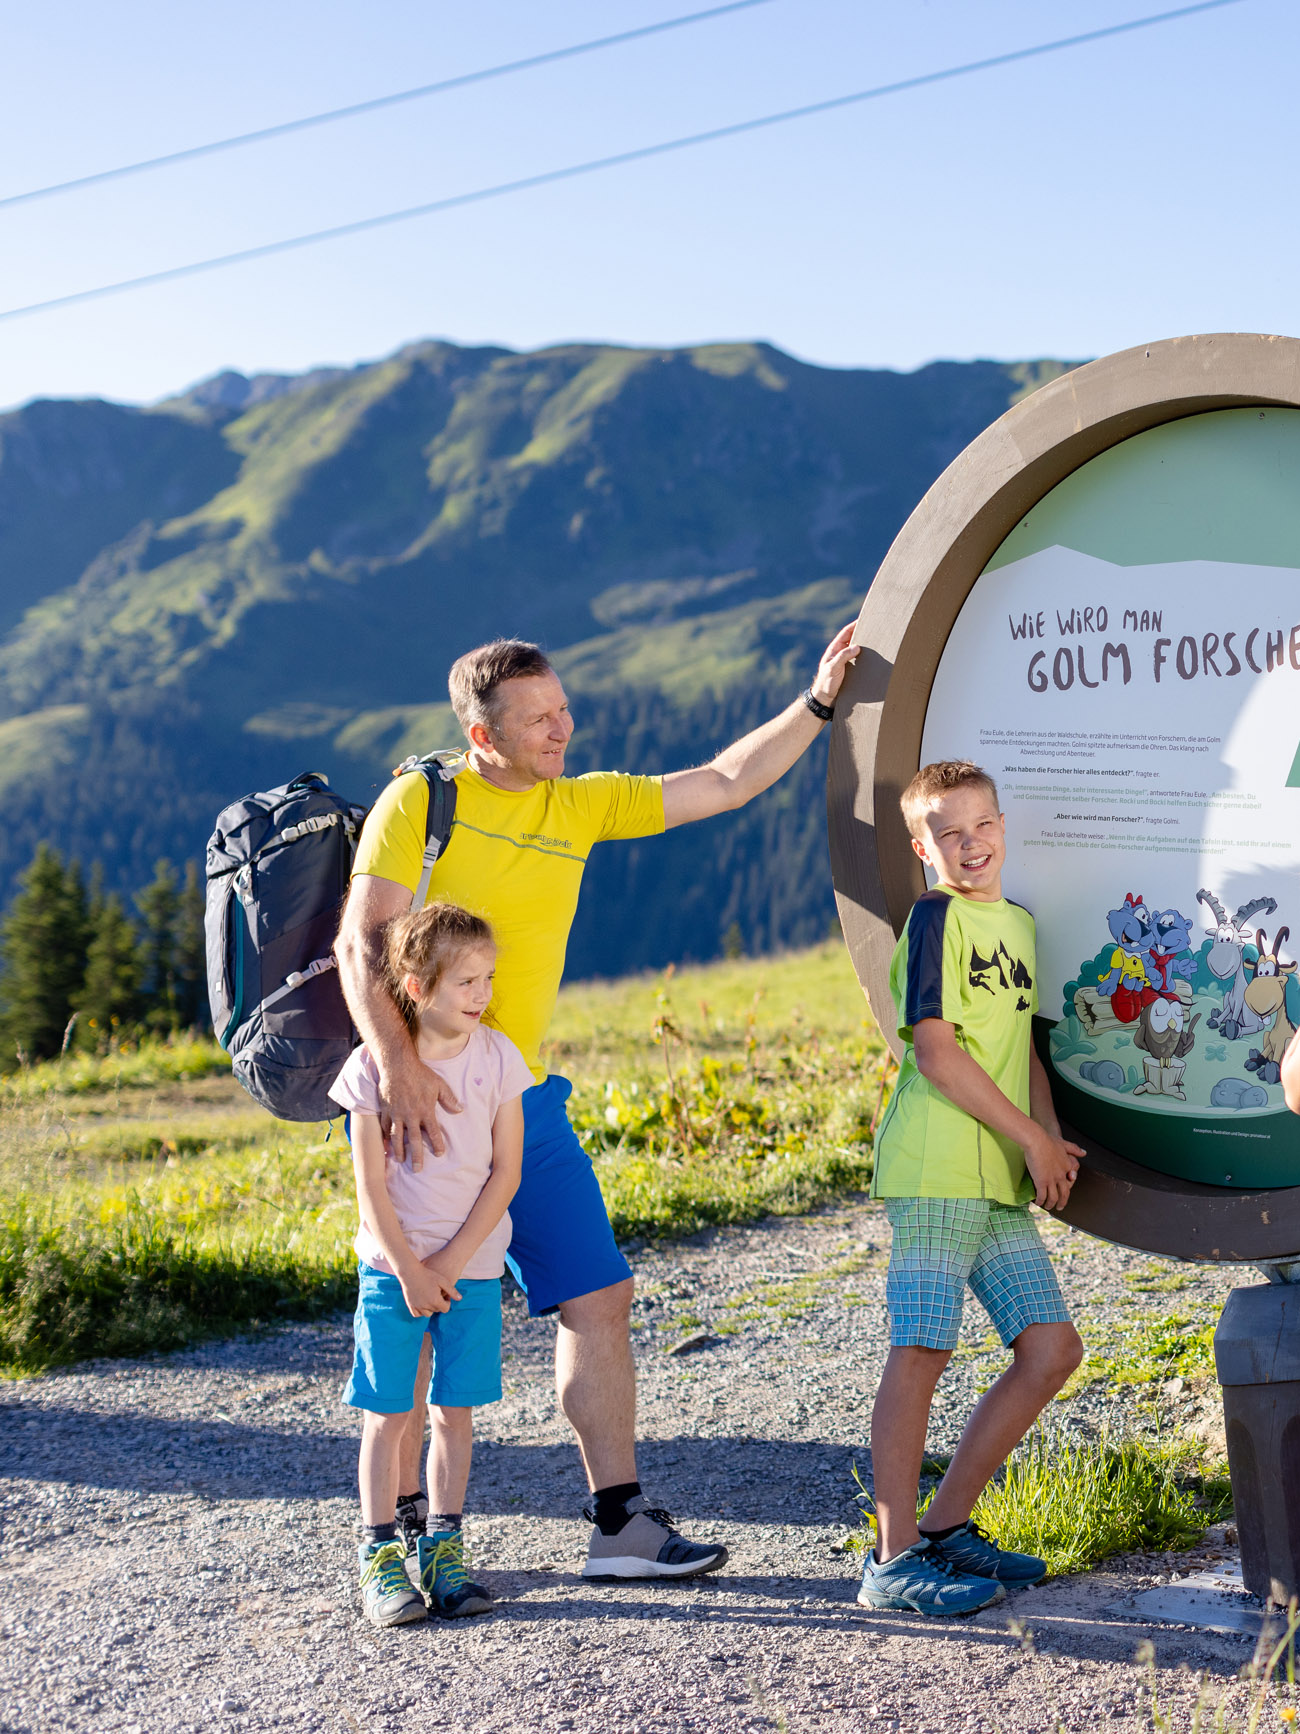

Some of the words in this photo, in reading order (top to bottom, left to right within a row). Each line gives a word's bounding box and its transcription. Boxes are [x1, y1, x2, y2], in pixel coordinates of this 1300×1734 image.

[1122, 609, 1163, 633] MAN
[1027, 642, 1132, 693] GOLM
[1057, 732, 1088, 740] Waldschule,
[1158, 735, 1187, 743] Forschern,
[980, 739, 1008, 747] spannende
[1008, 739, 1046, 748] Entdeckungen
[1088, 742, 1106, 750] spitzte
[1106, 742, 1140, 750] aufmerksam
[1180, 745, 1195, 753] klang
[1020, 748, 1056, 757] Abwechslung
[1135, 770, 1152, 778] fragte
[1015, 784, 1052, 792] interessante
[1086, 787, 1124, 795] interessante
[1149, 789, 1180, 797] antwortete
[1091, 796, 1118, 804] Forscher.
[1166, 799, 1187, 807] helfen
[1146, 817, 1162, 825] fragte
[1041, 830, 1053, 838] Frau
[1066, 831, 1087, 839] lächelte
[1088, 832, 1106, 840] weise:
[1146, 835, 1176, 844] Aufgaben
[1177, 836, 1188, 844] auf
[1201, 837, 1220, 845] Tafeln
[1023, 839, 1041, 848] guten
[1100, 843, 1144, 851] Golm-Forscher
[1144, 845, 1189, 854] aufgenommen
